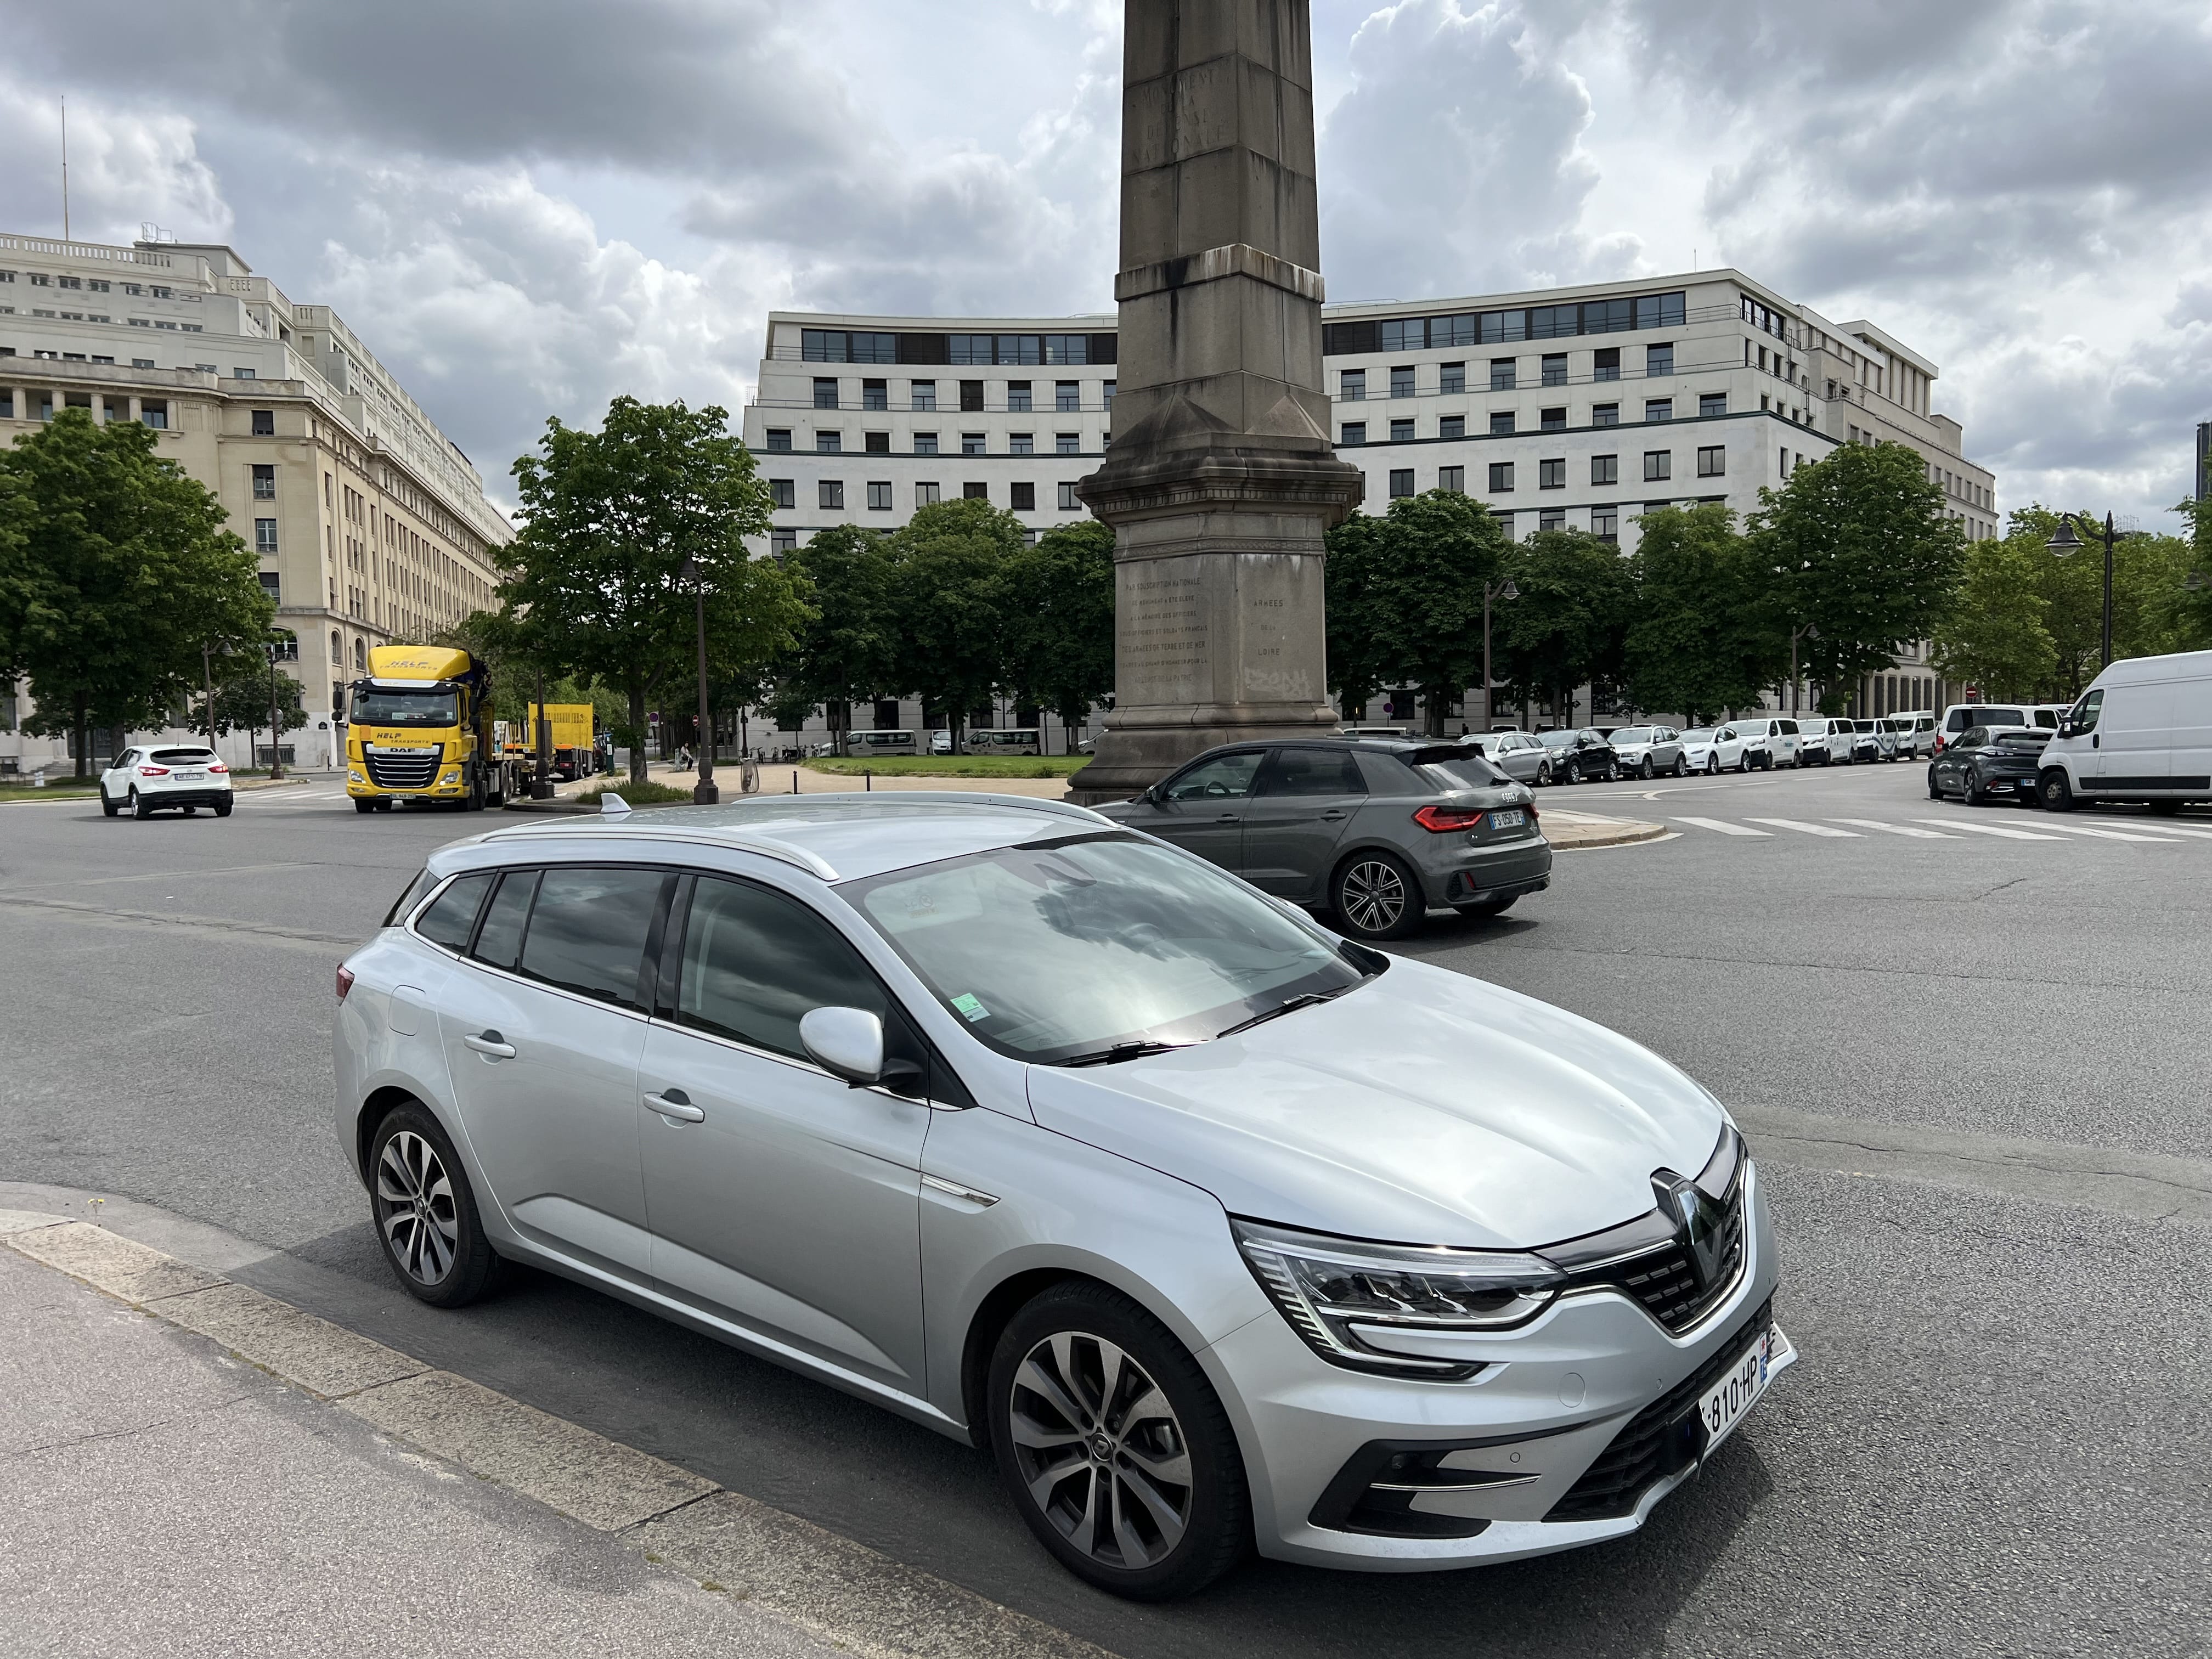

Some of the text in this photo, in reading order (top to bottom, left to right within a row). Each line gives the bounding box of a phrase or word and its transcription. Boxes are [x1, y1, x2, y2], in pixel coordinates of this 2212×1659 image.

[1172, 577, 1200, 587] NATIONALE
[1161, 642, 1177, 651] TERRE
[1492, 812, 1521, 827] FS-050-TE
[1702, 1355, 1757, 1432] -810-HP
